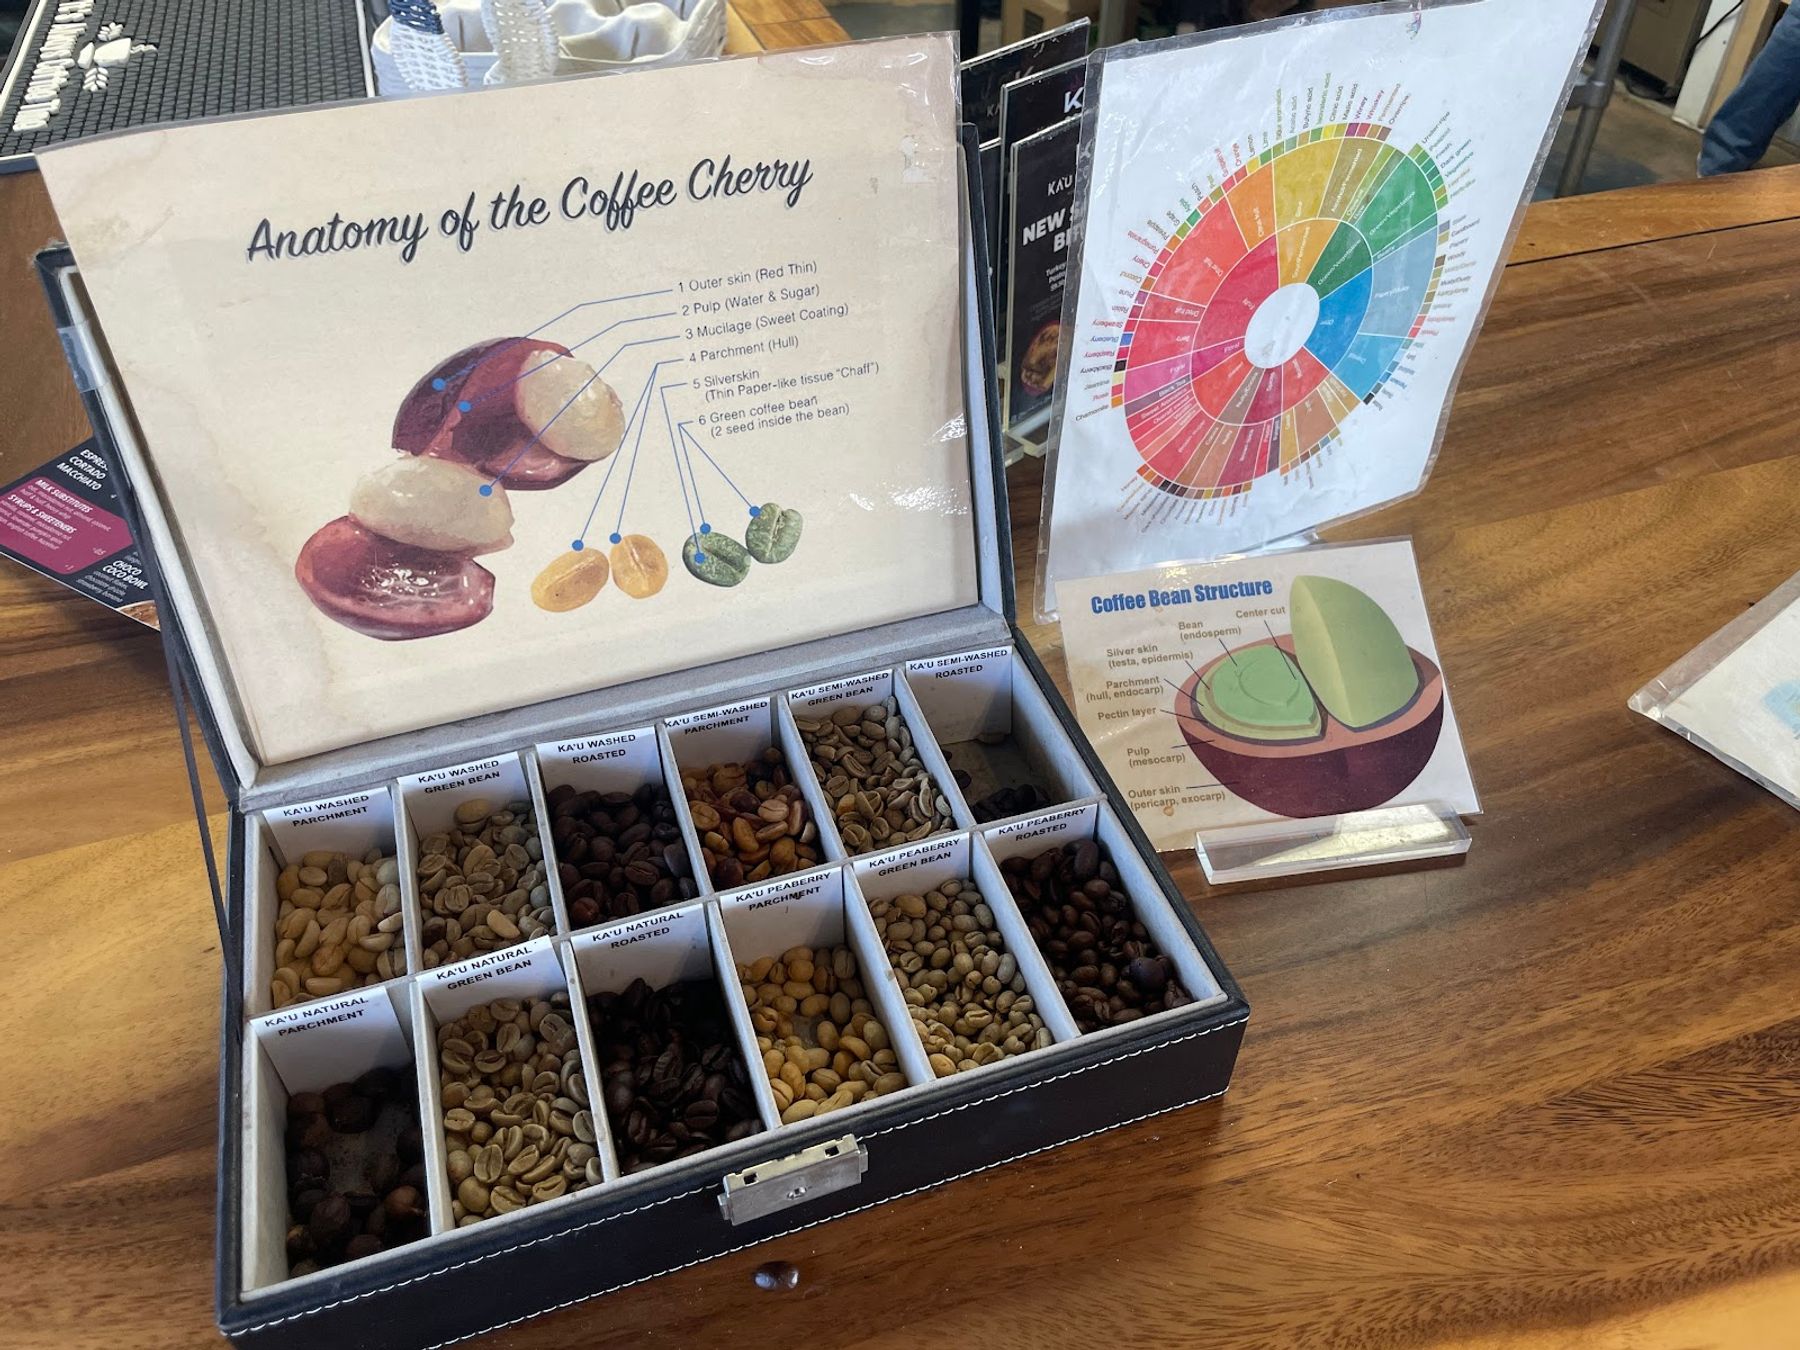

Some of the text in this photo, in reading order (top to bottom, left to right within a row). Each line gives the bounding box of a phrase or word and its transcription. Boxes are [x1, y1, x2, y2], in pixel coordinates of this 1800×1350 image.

[247, 154, 814, 263] Anatomy of the Coffee Cherry
[1166, 210, 1181, 226] Grape
[1023, 208, 1066, 246] NEW
[1133, 255, 1150, 269] Cherry
[678, 261, 817, 292] 1 Outer skin (Red Thin)
[682, 284, 819, 316] 2 Pulp (Water & Sugar)
[685, 303, 848, 340] 3 Mucilage (Sweet Coating)
[1092, 319, 1124, 328] Strawberry
[1090, 335, 1120, 343] Blueberry
[689, 336, 798, 363] 4 Parchment (Hull)
[1080, 364, 1113, 374] Blackberry
[693, 370, 759, 389] 5 Silverskin
[706, 385, 734, 403] (Thin
[738, 377, 797, 396] Paper-like
[801, 372, 834, 385] tissue
[699, 396, 818, 425] 6 Green coffee bean
[711, 403, 850, 438] (2 seed inside the bean)
[57, 463, 102, 491] MACCHIATO
[69, 456, 106, 479] CORTADO
[35, 480, 54, 494] MILK
[103, 565, 127, 578] COCO
[123, 575, 148, 590] BOWL
[113, 560, 142, 575] CHOCO
[1091, 580, 1273, 614] Coffee Bean Structure
[1236, 606, 1286, 618] Center cut
[1178, 621, 1203, 630] Bean
[1180, 627, 1241, 641] (endosperm)
[937, 649, 1008, 666] SEMI-WASHED
[1107, 644, 1158, 657] Silver skin
[1108, 651, 1193, 669] (testa, epidermis)
[935, 665, 983, 678] ROASTED
[819, 673, 889, 693] SEMI-WASHED
[1106, 677, 1159, 689] Parchment
[808, 686, 873, 707] GREEN BEAN
[1087, 686, 1164, 702] (hull, endocarp)
[693, 701, 768, 723] SEMI-WASHED
[1098, 707, 1156, 720] Pectin layer
[684, 715, 749, 735] PARCHMENT
[588, 735, 636, 748] WASHED
[573, 749, 626, 764] ROASTED
[1127, 748, 1150, 756] Pulp
[1129, 753, 1186, 768] (mesocarp)
[449, 760, 499, 777] WASHED
[424, 771, 500, 794] GREEN BEAN
[1128, 786, 1180, 799] Outer skin
[317, 795, 369, 811] WASHED
[1131, 791, 1225, 811] (pericarp, exocarp)
[292, 806, 369, 827] PARCHMENT
[1027, 808, 1086, 828] PEABERRY
[1016, 823, 1067, 841] ROASTED
[899, 839, 960, 859] PEABERRY
[878, 852, 951, 877] GREEN BEAN
[768, 873, 831, 894] PEABERRY
[749, 887, 821, 911] PARCHMENT
[626, 913, 683, 933] NATURAL
[611, 927, 670, 949] ROASTED
[472, 948, 532, 970] NATURAL
[447, 960, 532, 990] GREEN BEAN
[303, 997, 368, 1018] NATURAL
[278, 1009, 364, 1036] PARCHMENT
